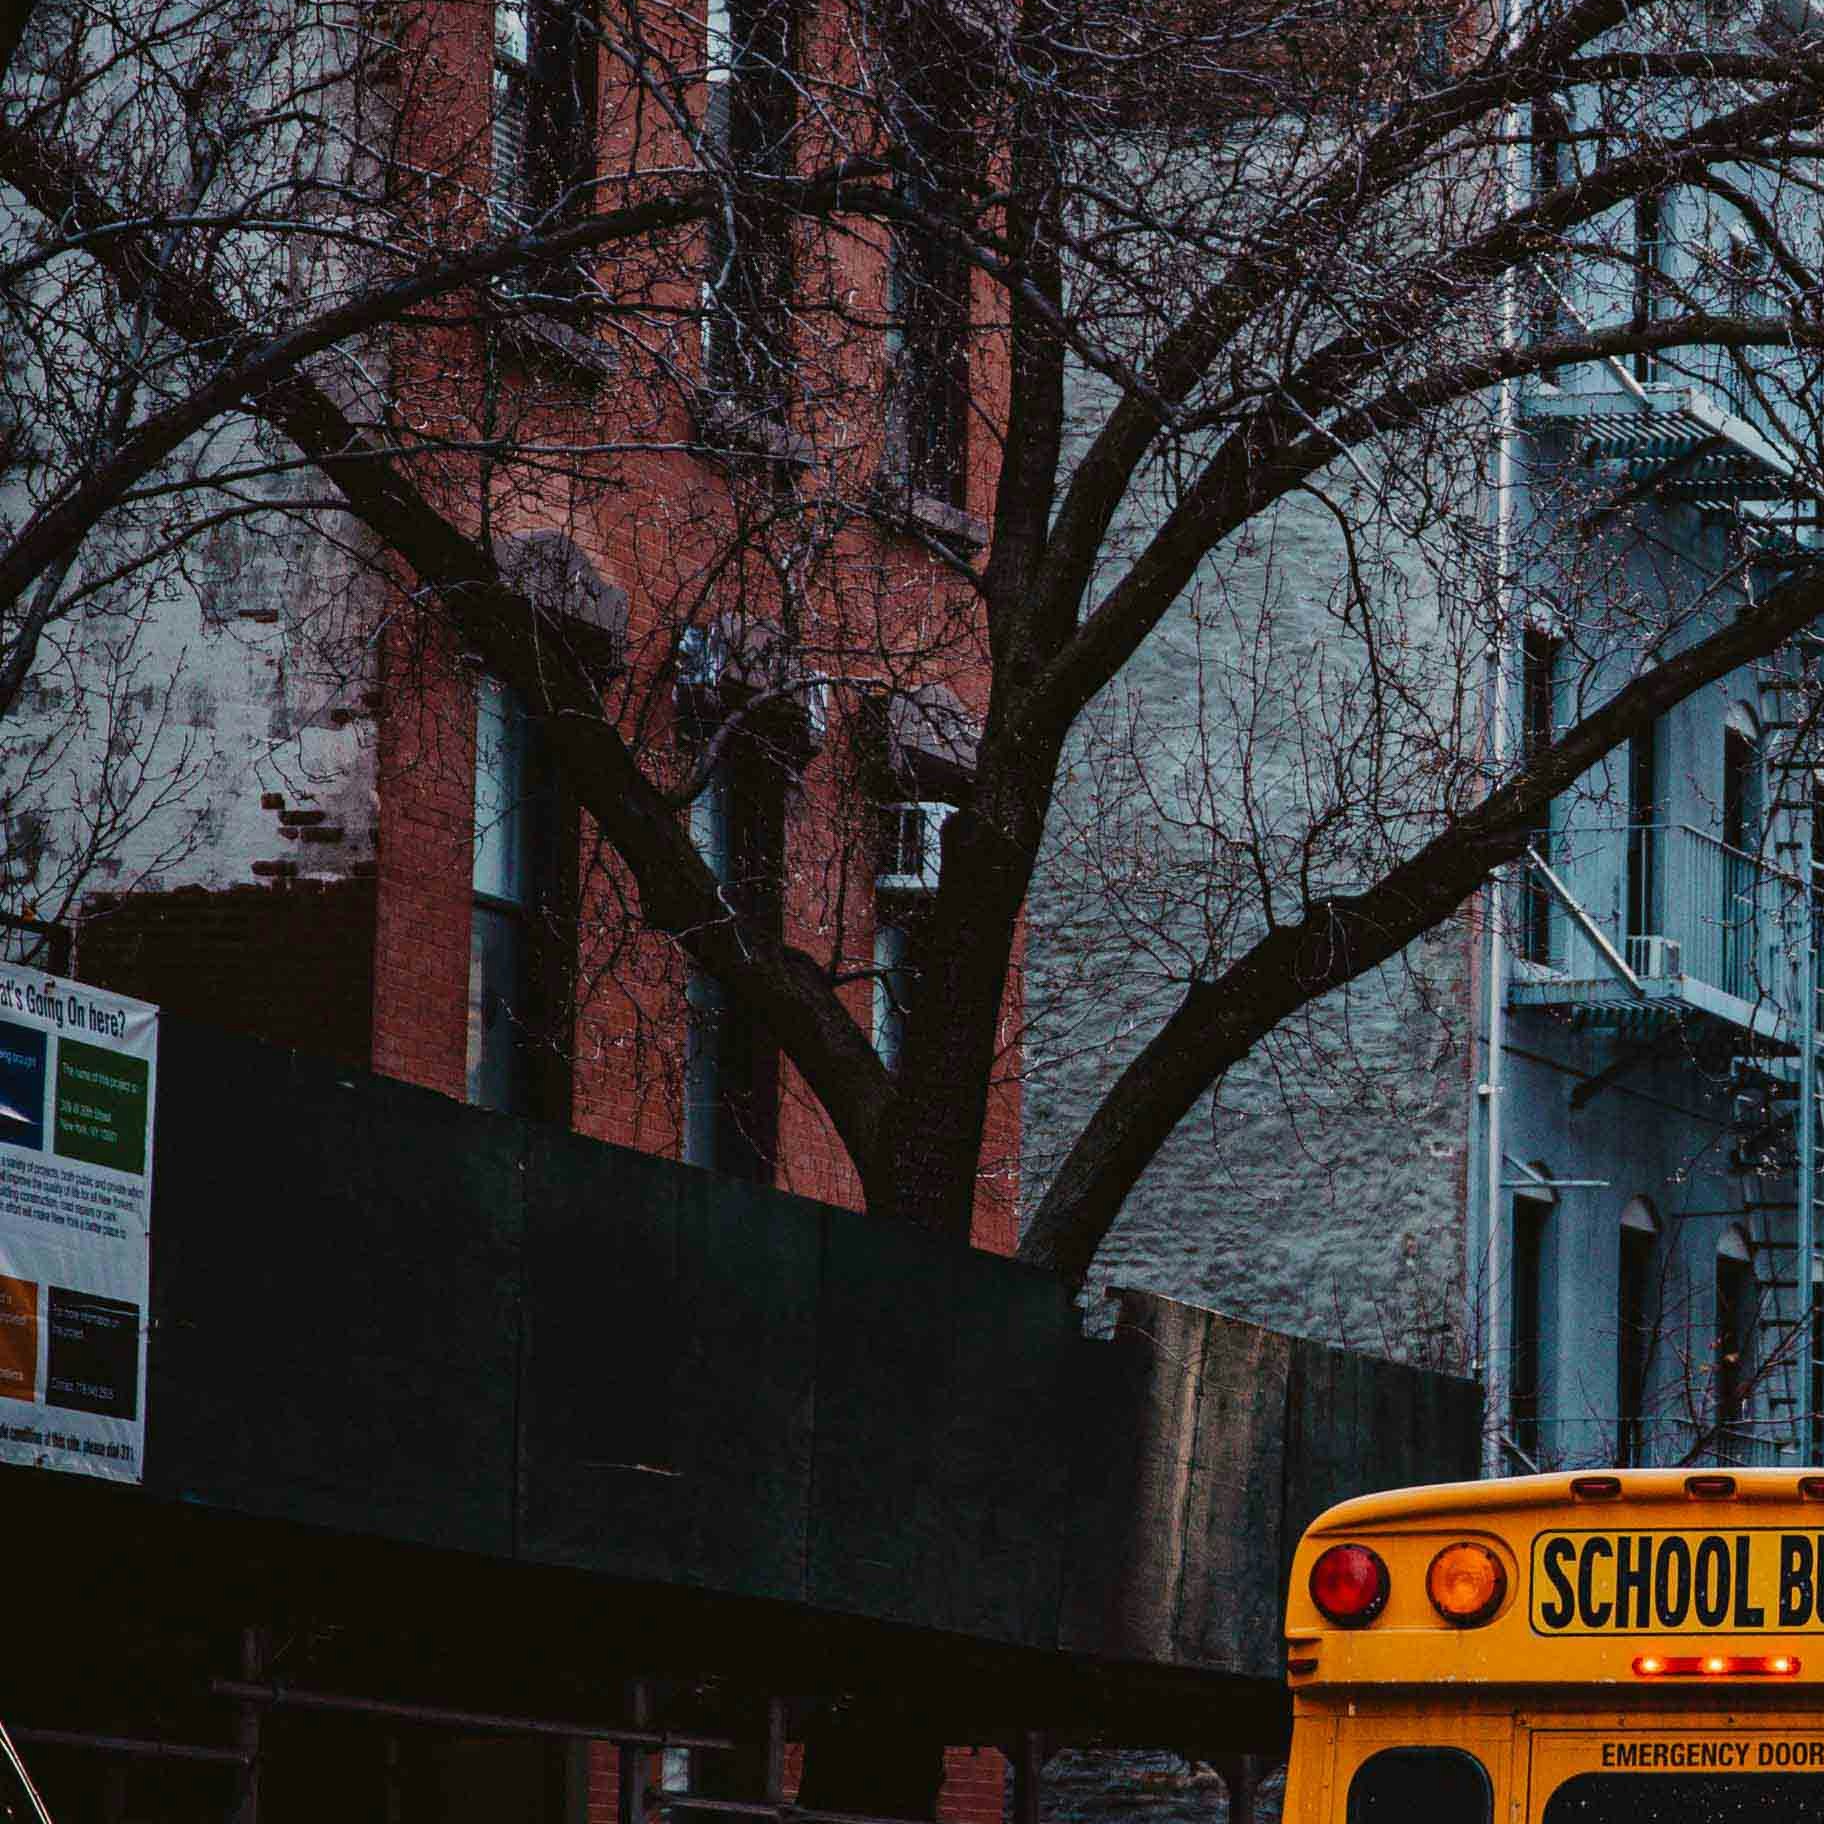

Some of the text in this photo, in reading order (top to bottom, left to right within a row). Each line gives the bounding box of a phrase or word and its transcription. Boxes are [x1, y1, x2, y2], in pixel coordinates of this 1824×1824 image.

[26, 984, 63, 1028] Going
[68, 995, 85, 1027] On
[88, 1001, 126, 1039] here?
[1542, 1535, 1764, 1629] SCHOOL
[1602, 1742, 1824, 1767] EMERGENCY DOOR
